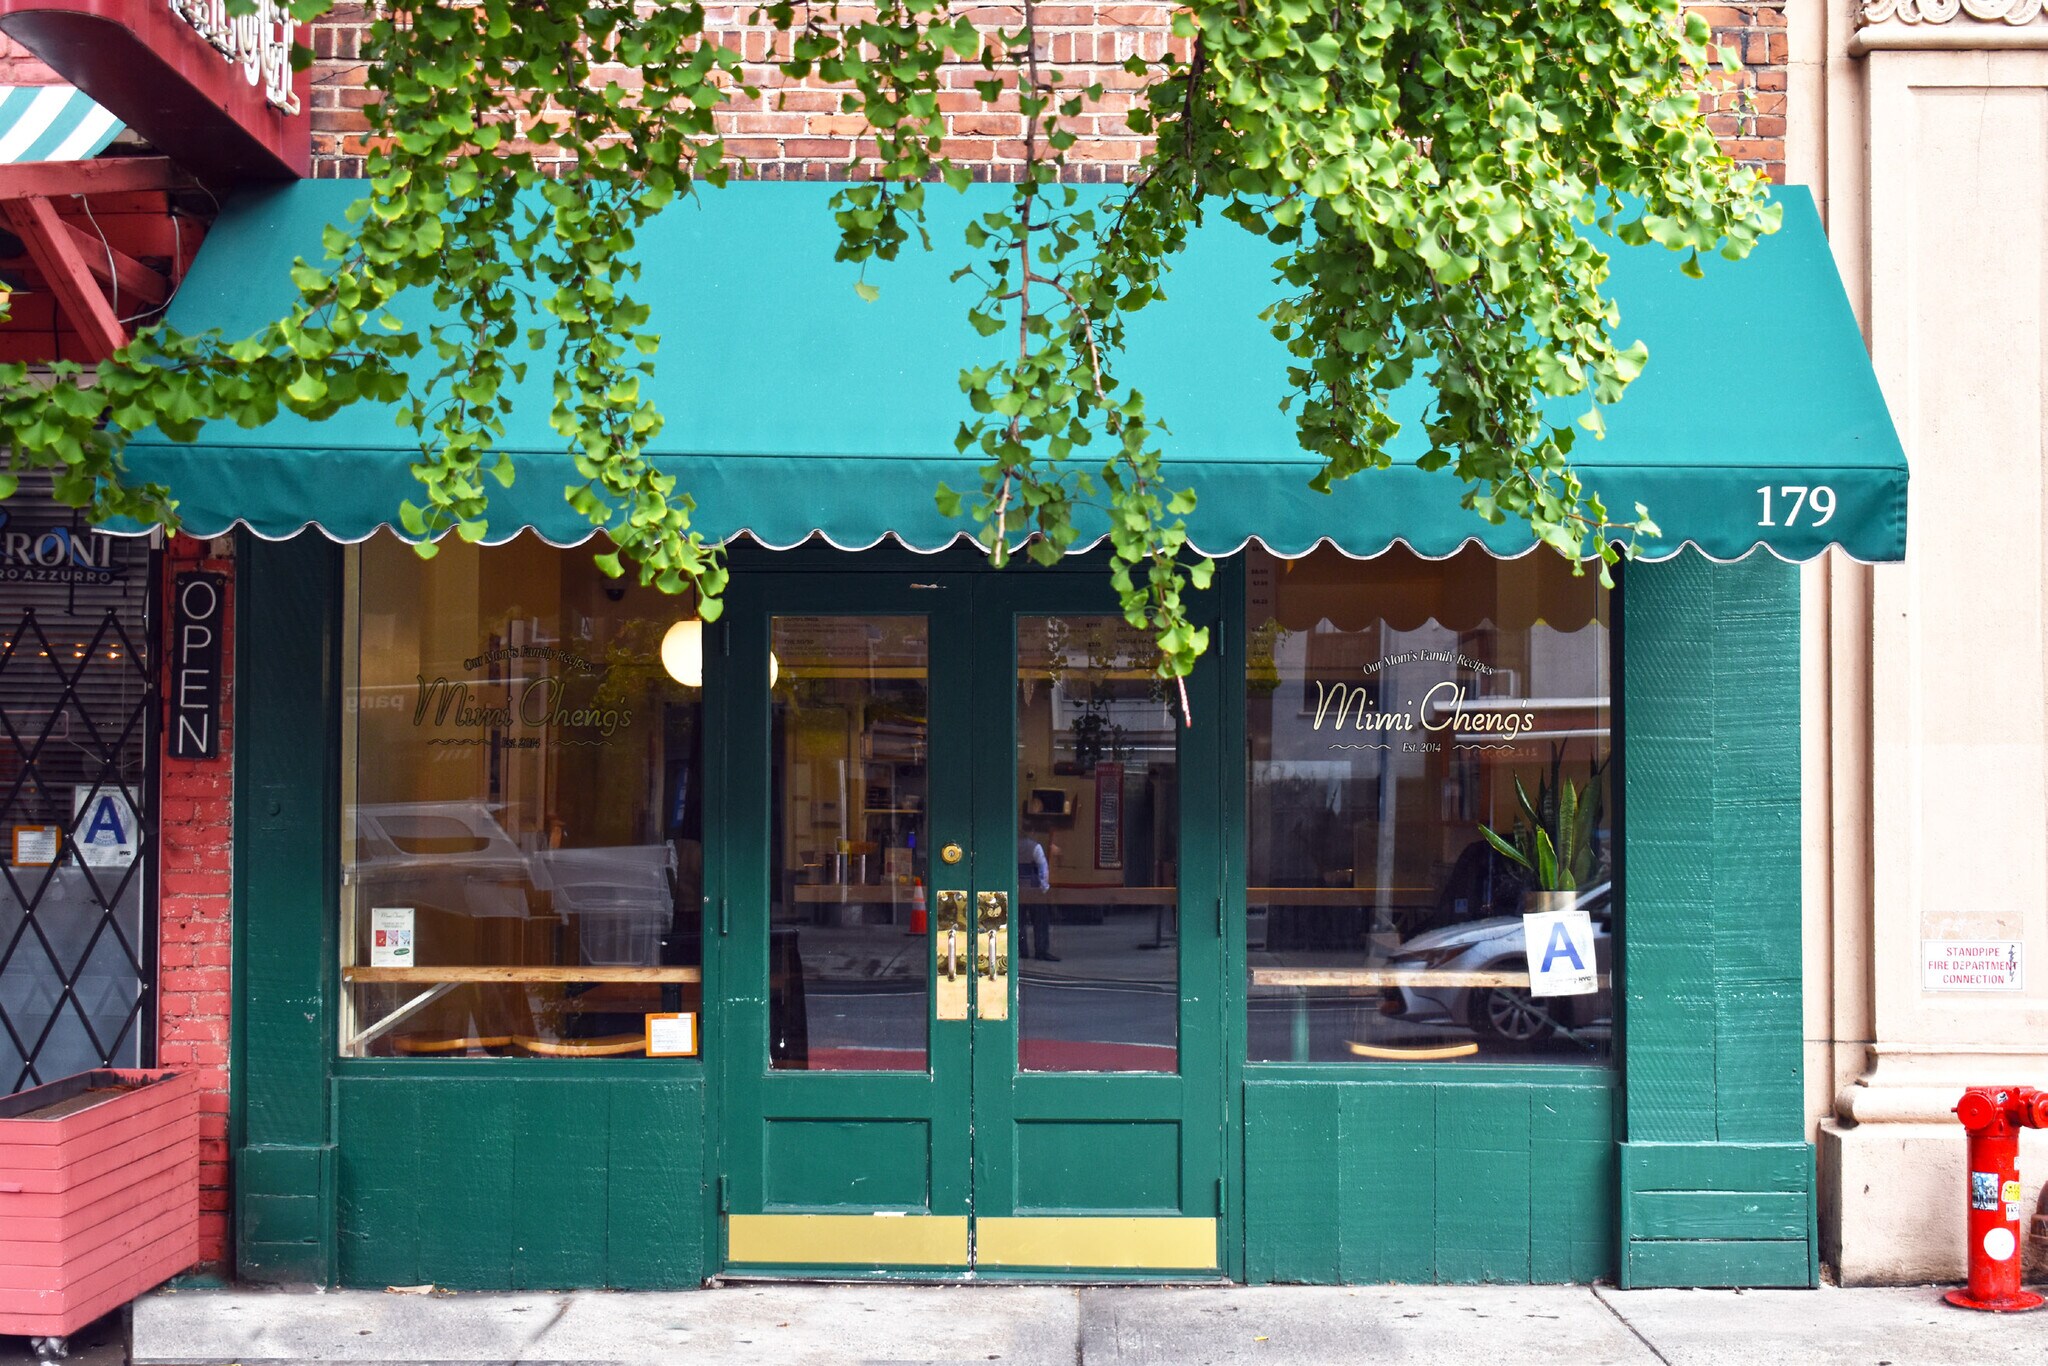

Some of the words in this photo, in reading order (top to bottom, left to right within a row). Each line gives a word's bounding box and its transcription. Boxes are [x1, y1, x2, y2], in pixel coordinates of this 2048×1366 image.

[1757, 486, 1837, 527] 179
[24, 570, 111, 582] AZZURRO
[178, 581, 217, 754] OPEN
[463, 656, 484, 671] Our
[520, 645, 556, 661] Family
[557, 651, 593, 672] Recipes
[1363, 660, 1382, 675] Our
[1384, 650, 1418, 668] Mom's
[1420, 649, 1455, 665] Family
[1456, 653, 1496, 676] Recipes
[413, 675, 514, 727] Mimi
[519, 676, 633, 737] Cheng's
[1313, 680, 1414, 731] Mimi
[1420, 681, 1535, 741] Cheng's
[518, 737, 541, 748] 2014
[1402, 742, 1418, 752] Est.
[1419, 742, 1441, 753] 2014
[83, 796, 127, 844] A
[1540, 921, 1585, 973] A
[1946, 947, 2000, 957] STANDPIPE
[1928, 960, 1949, 970] FIRE
[1952, 960, 2018, 971] DEPARTMENT
[1942, 974, 2005, 984] CONNECTION
